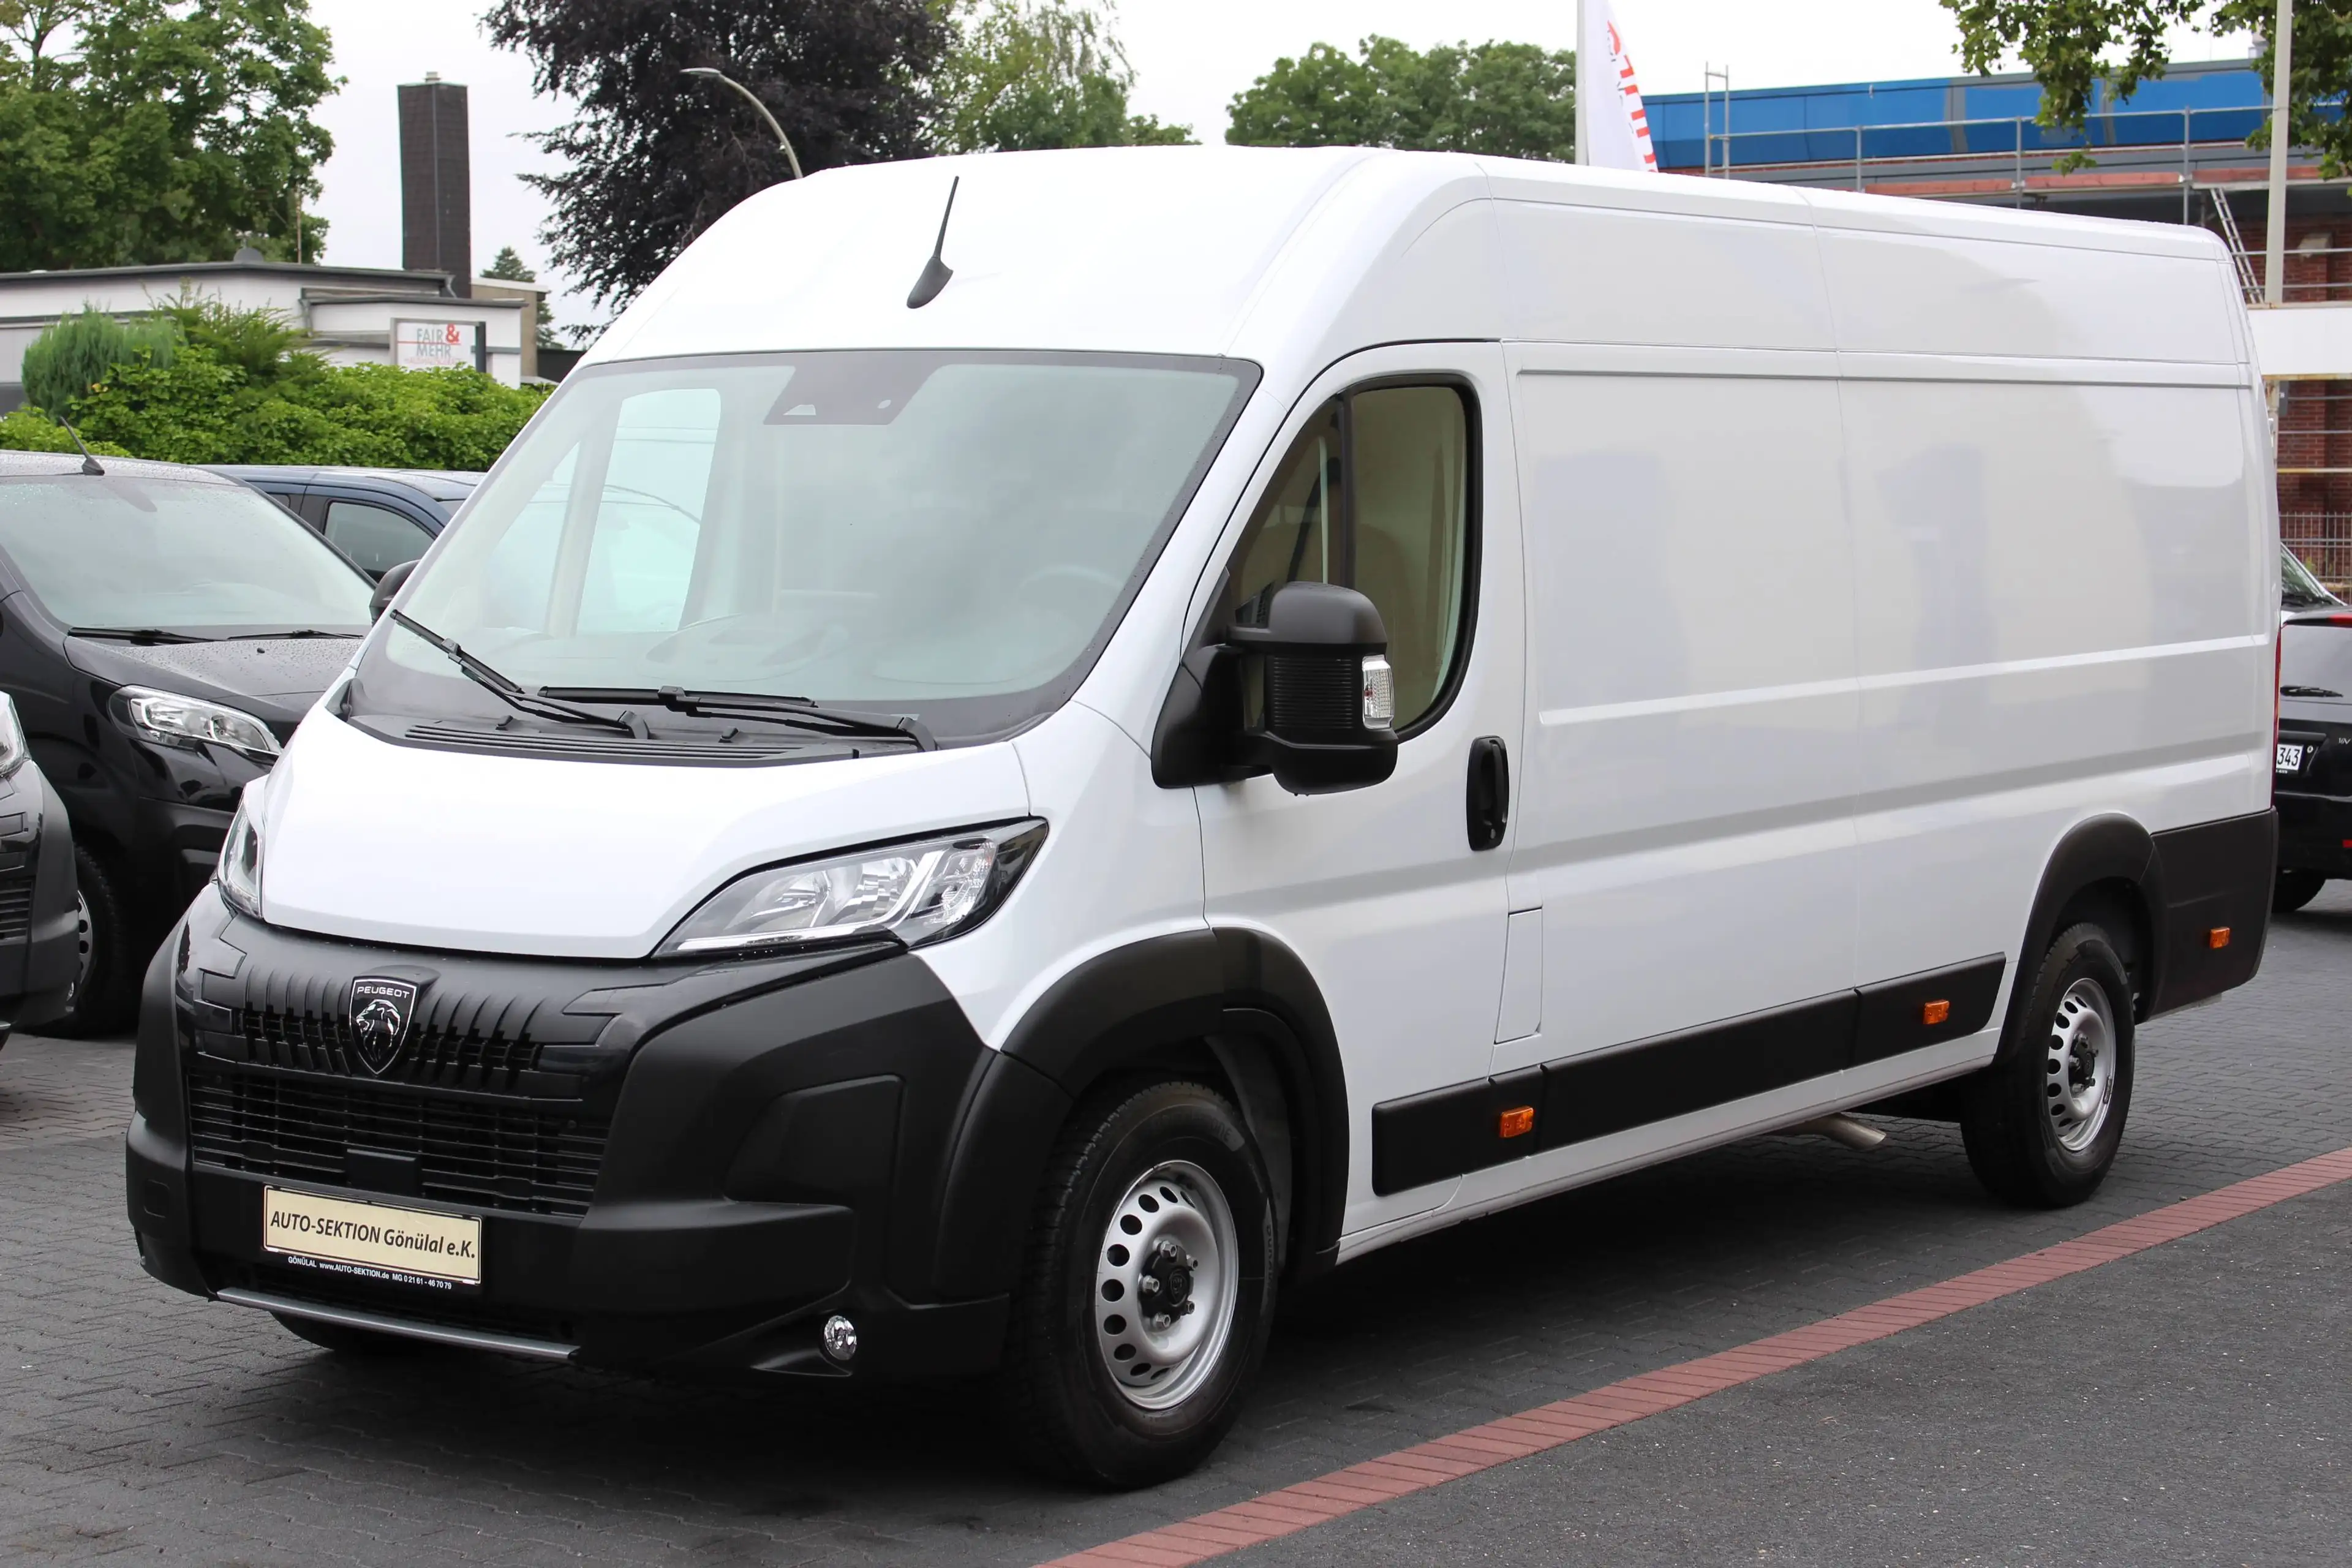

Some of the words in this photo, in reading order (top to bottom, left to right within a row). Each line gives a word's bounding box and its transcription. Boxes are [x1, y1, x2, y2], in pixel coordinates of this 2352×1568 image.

[417, 328, 444, 344] FAIR
[446, 323, 461, 344] &
[417, 344, 451, 358] MEHR
[2277, 747, 2300, 766] 343
[357, 986, 410, 998] PEUGEOT
[270, 1210, 381, 1244] AUTO-SEKTION
[383, 1229, 444, 1254] Gönülal
[447, 1240, 475, 1259] e.K.
[288, 1256, 317, 1268] GÖNÜLAL
[319, 1262, 390, 1280] www.AUTO-SEKTION.de
[392, 1273, 403, 1282] MG
